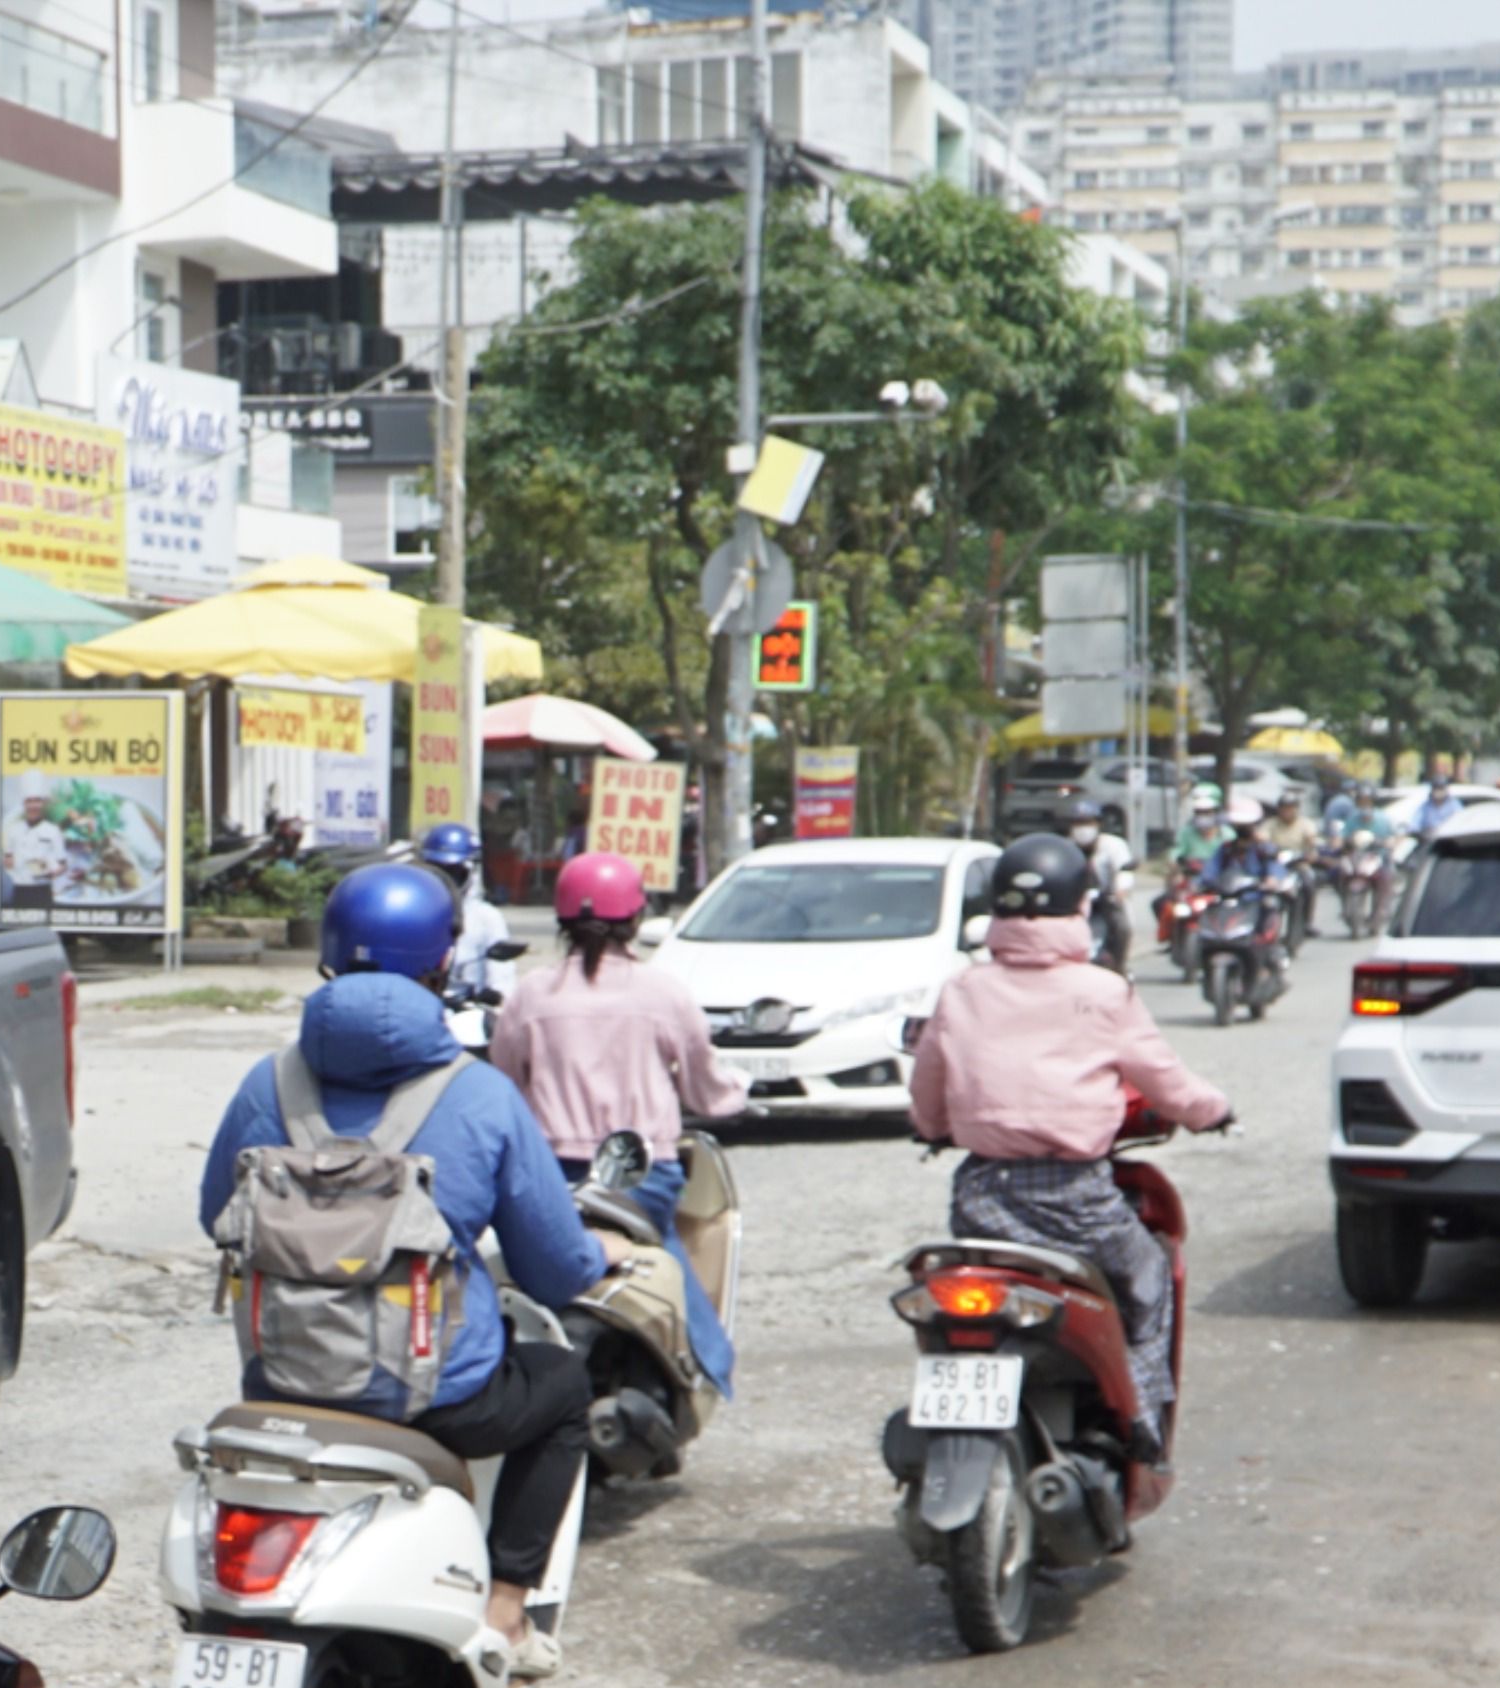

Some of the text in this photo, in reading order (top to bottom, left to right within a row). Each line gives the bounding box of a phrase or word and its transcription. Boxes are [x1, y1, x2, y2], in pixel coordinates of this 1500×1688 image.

[8, 731, 161, 770] BÚN SỤN BÒ
[602, 765, 678, 793] PHOTO
[602, 793, 665, 822] IN
[597, 823, 672, 858] SCAN
[194, 1642, 281, 1688] 59-B1
